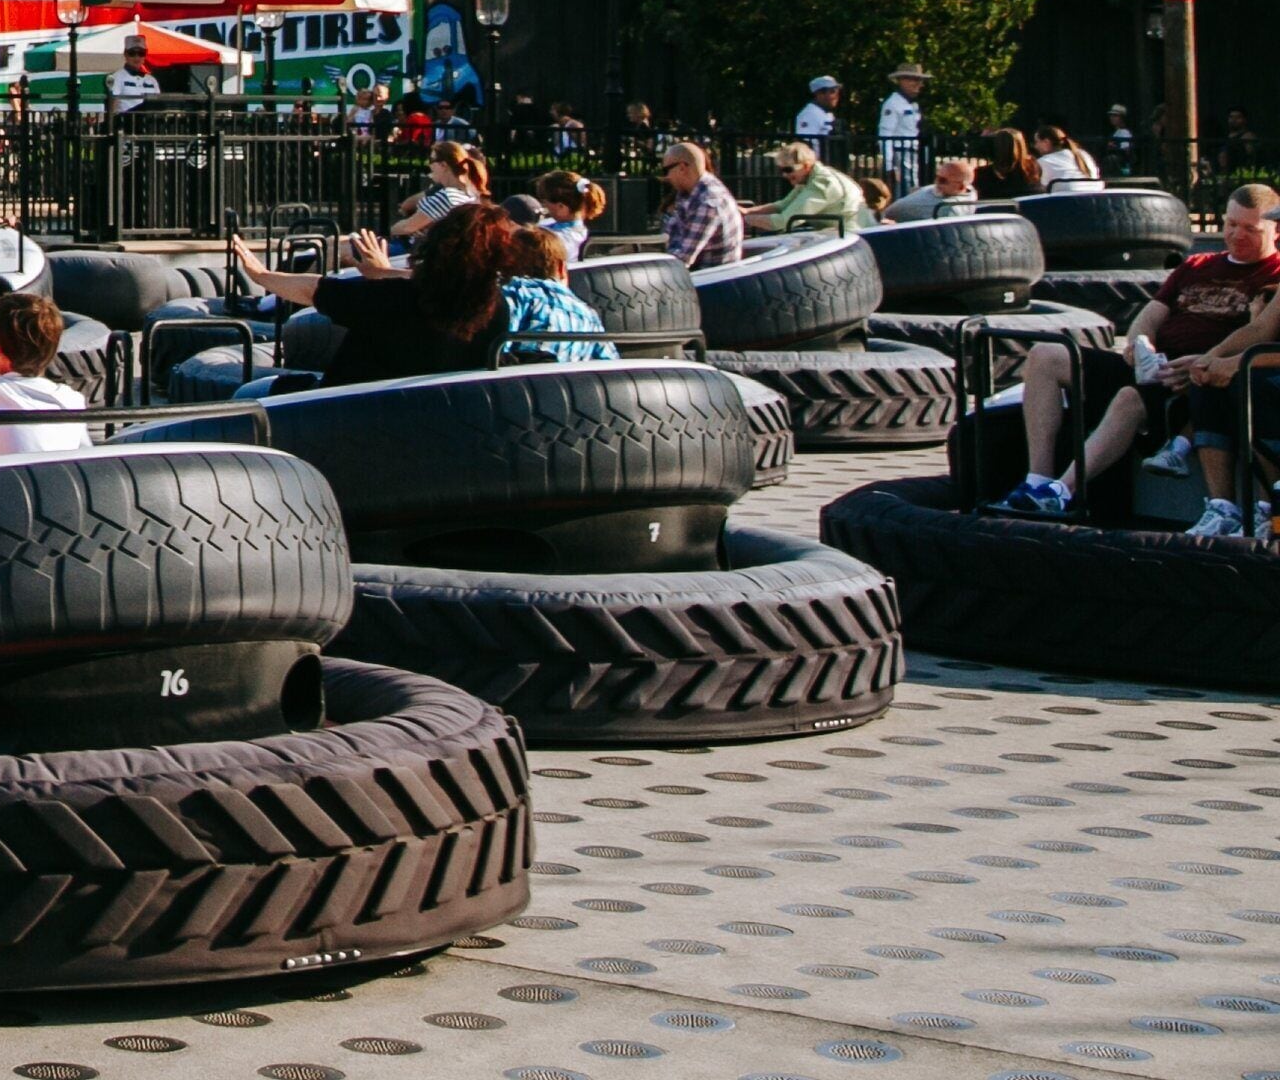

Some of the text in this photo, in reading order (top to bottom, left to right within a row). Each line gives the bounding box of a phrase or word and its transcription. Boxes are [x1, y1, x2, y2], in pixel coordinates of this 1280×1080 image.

[280, 11, 402, 52] TIRES
[648, 522, 661, 543] 7
[160, 668, 189, 697] 16
